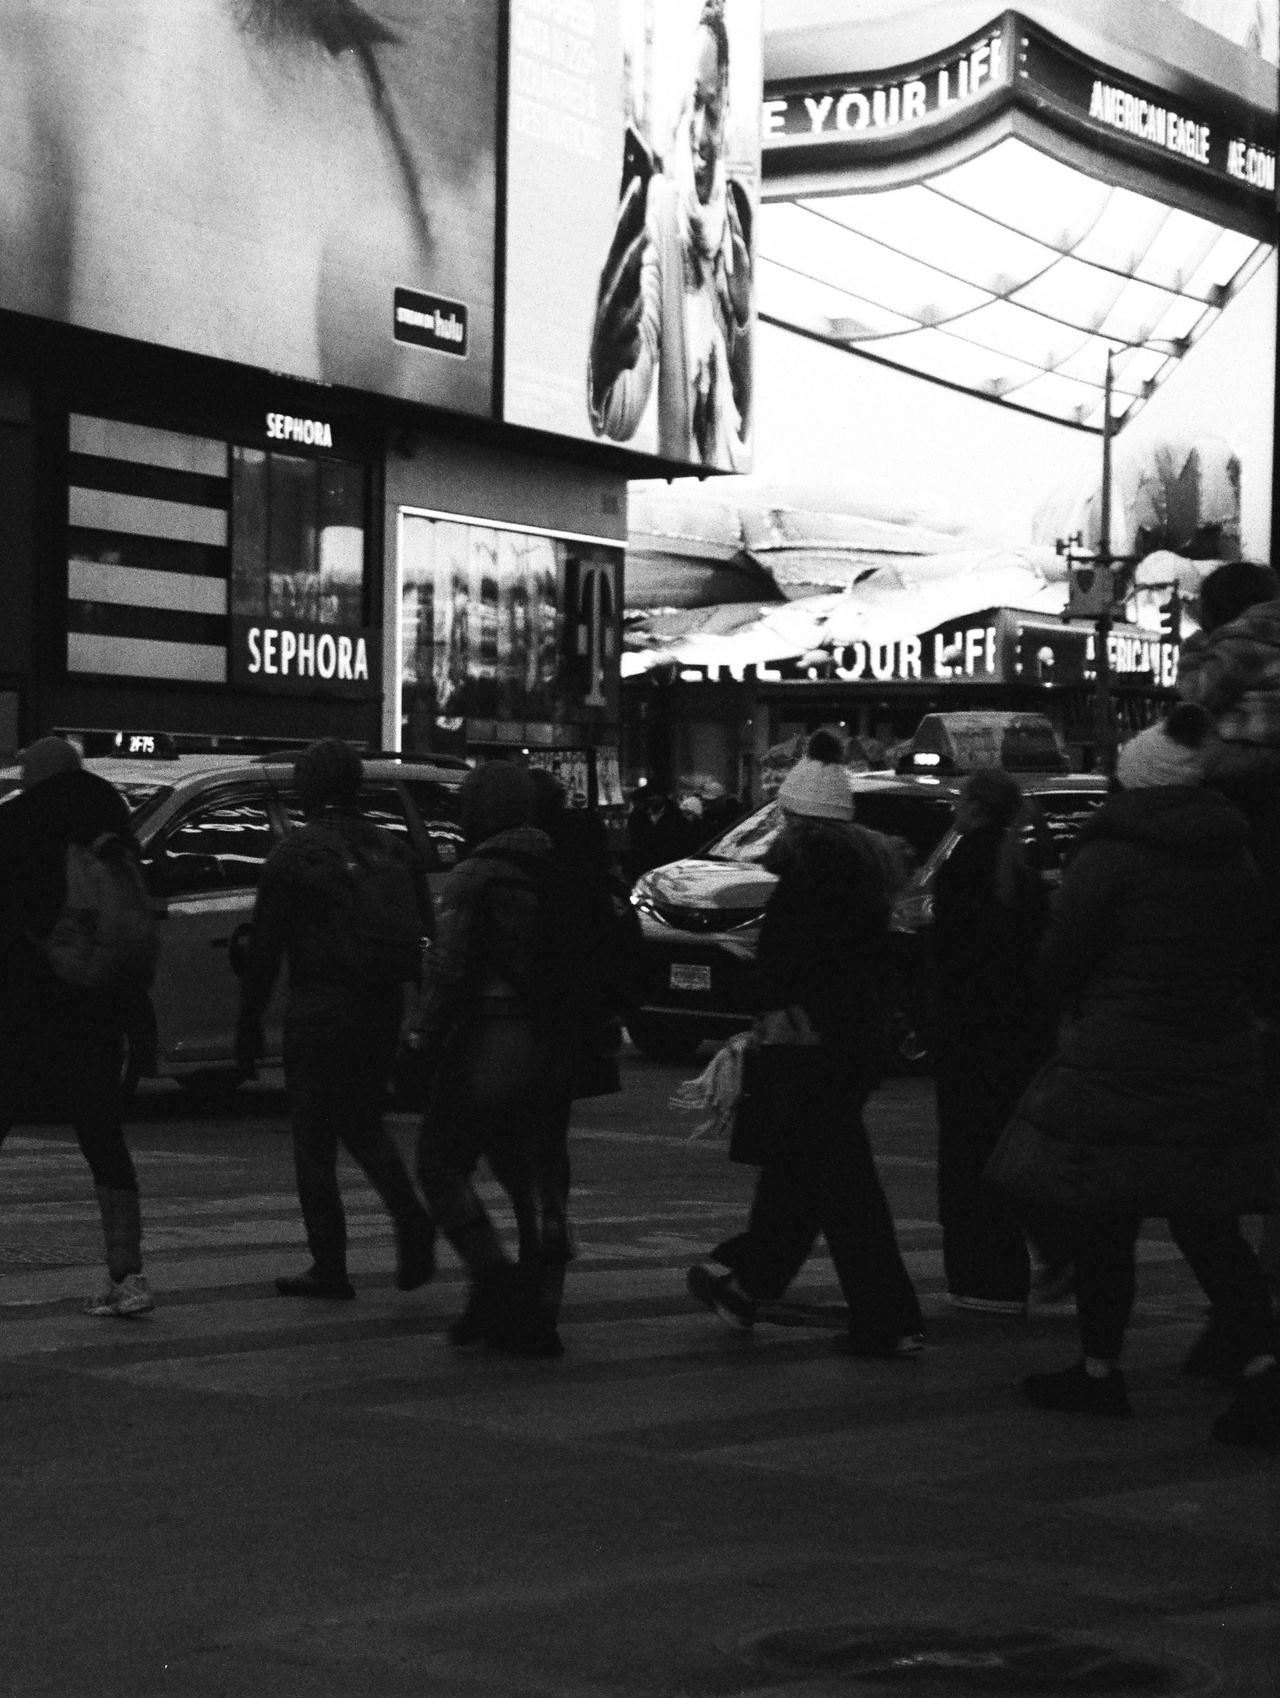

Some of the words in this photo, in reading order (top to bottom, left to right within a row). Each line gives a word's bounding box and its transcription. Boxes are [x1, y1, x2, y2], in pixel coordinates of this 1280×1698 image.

[804, 81, 927, 135] YOUR
[1089, 80, 1166, 147] AMERICAN
[1166, 111, 1210, 165] EAGLE
[266, 412, 332, 448] SEPHORA
[247, 627, 368, 680] SEPHORA
[808, 634, 921, 681] OUR
